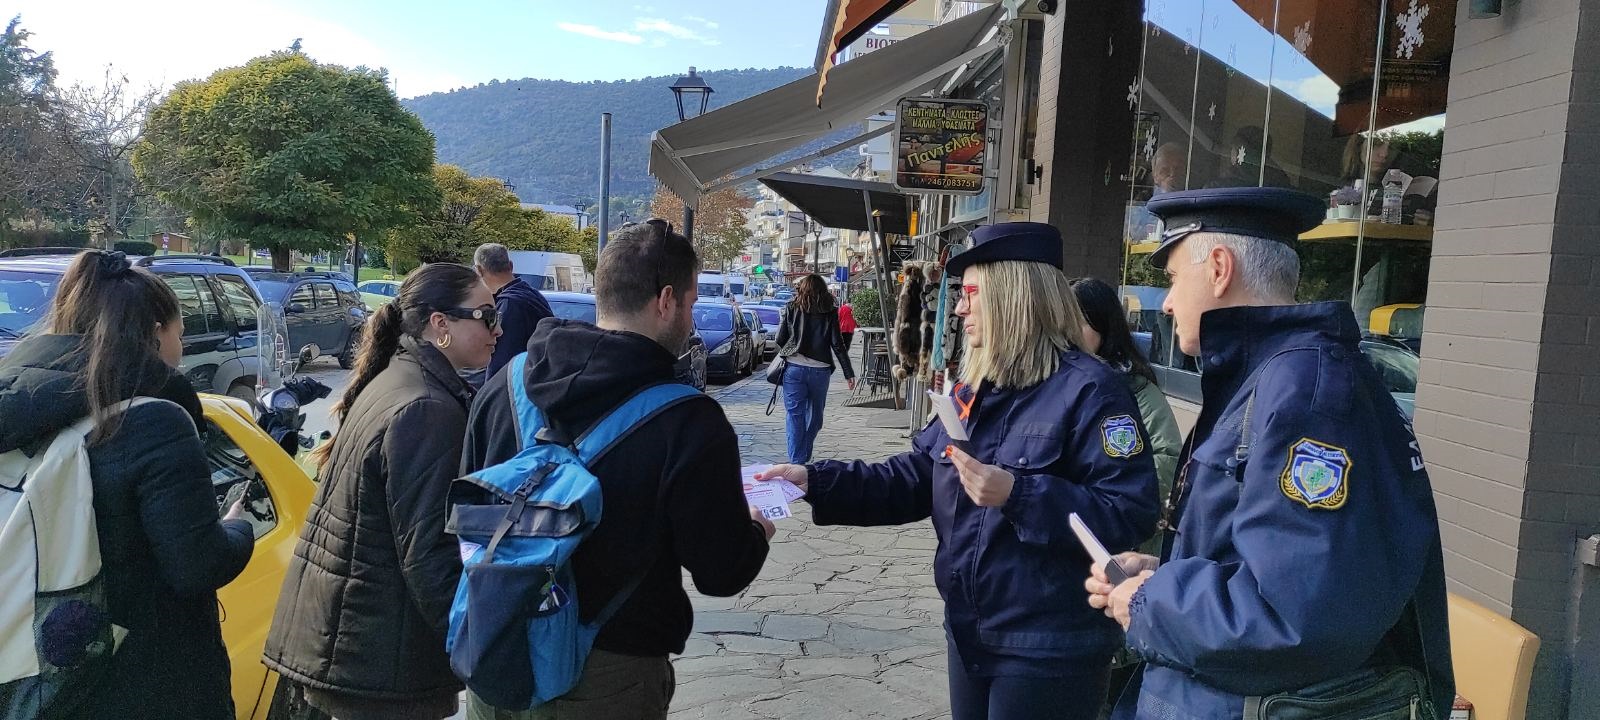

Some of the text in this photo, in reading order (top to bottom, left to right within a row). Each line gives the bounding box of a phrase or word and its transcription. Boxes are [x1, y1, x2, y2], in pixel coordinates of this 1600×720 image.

[908, 107, 980, 120] ΚΕΝΤΗΜΑΤΑ ΚΛΩΣΤΕΣ
[912, 119, 976, 131] ΜΑΛΛΙΑ ΥΦΑΣΜΑΤΑ
